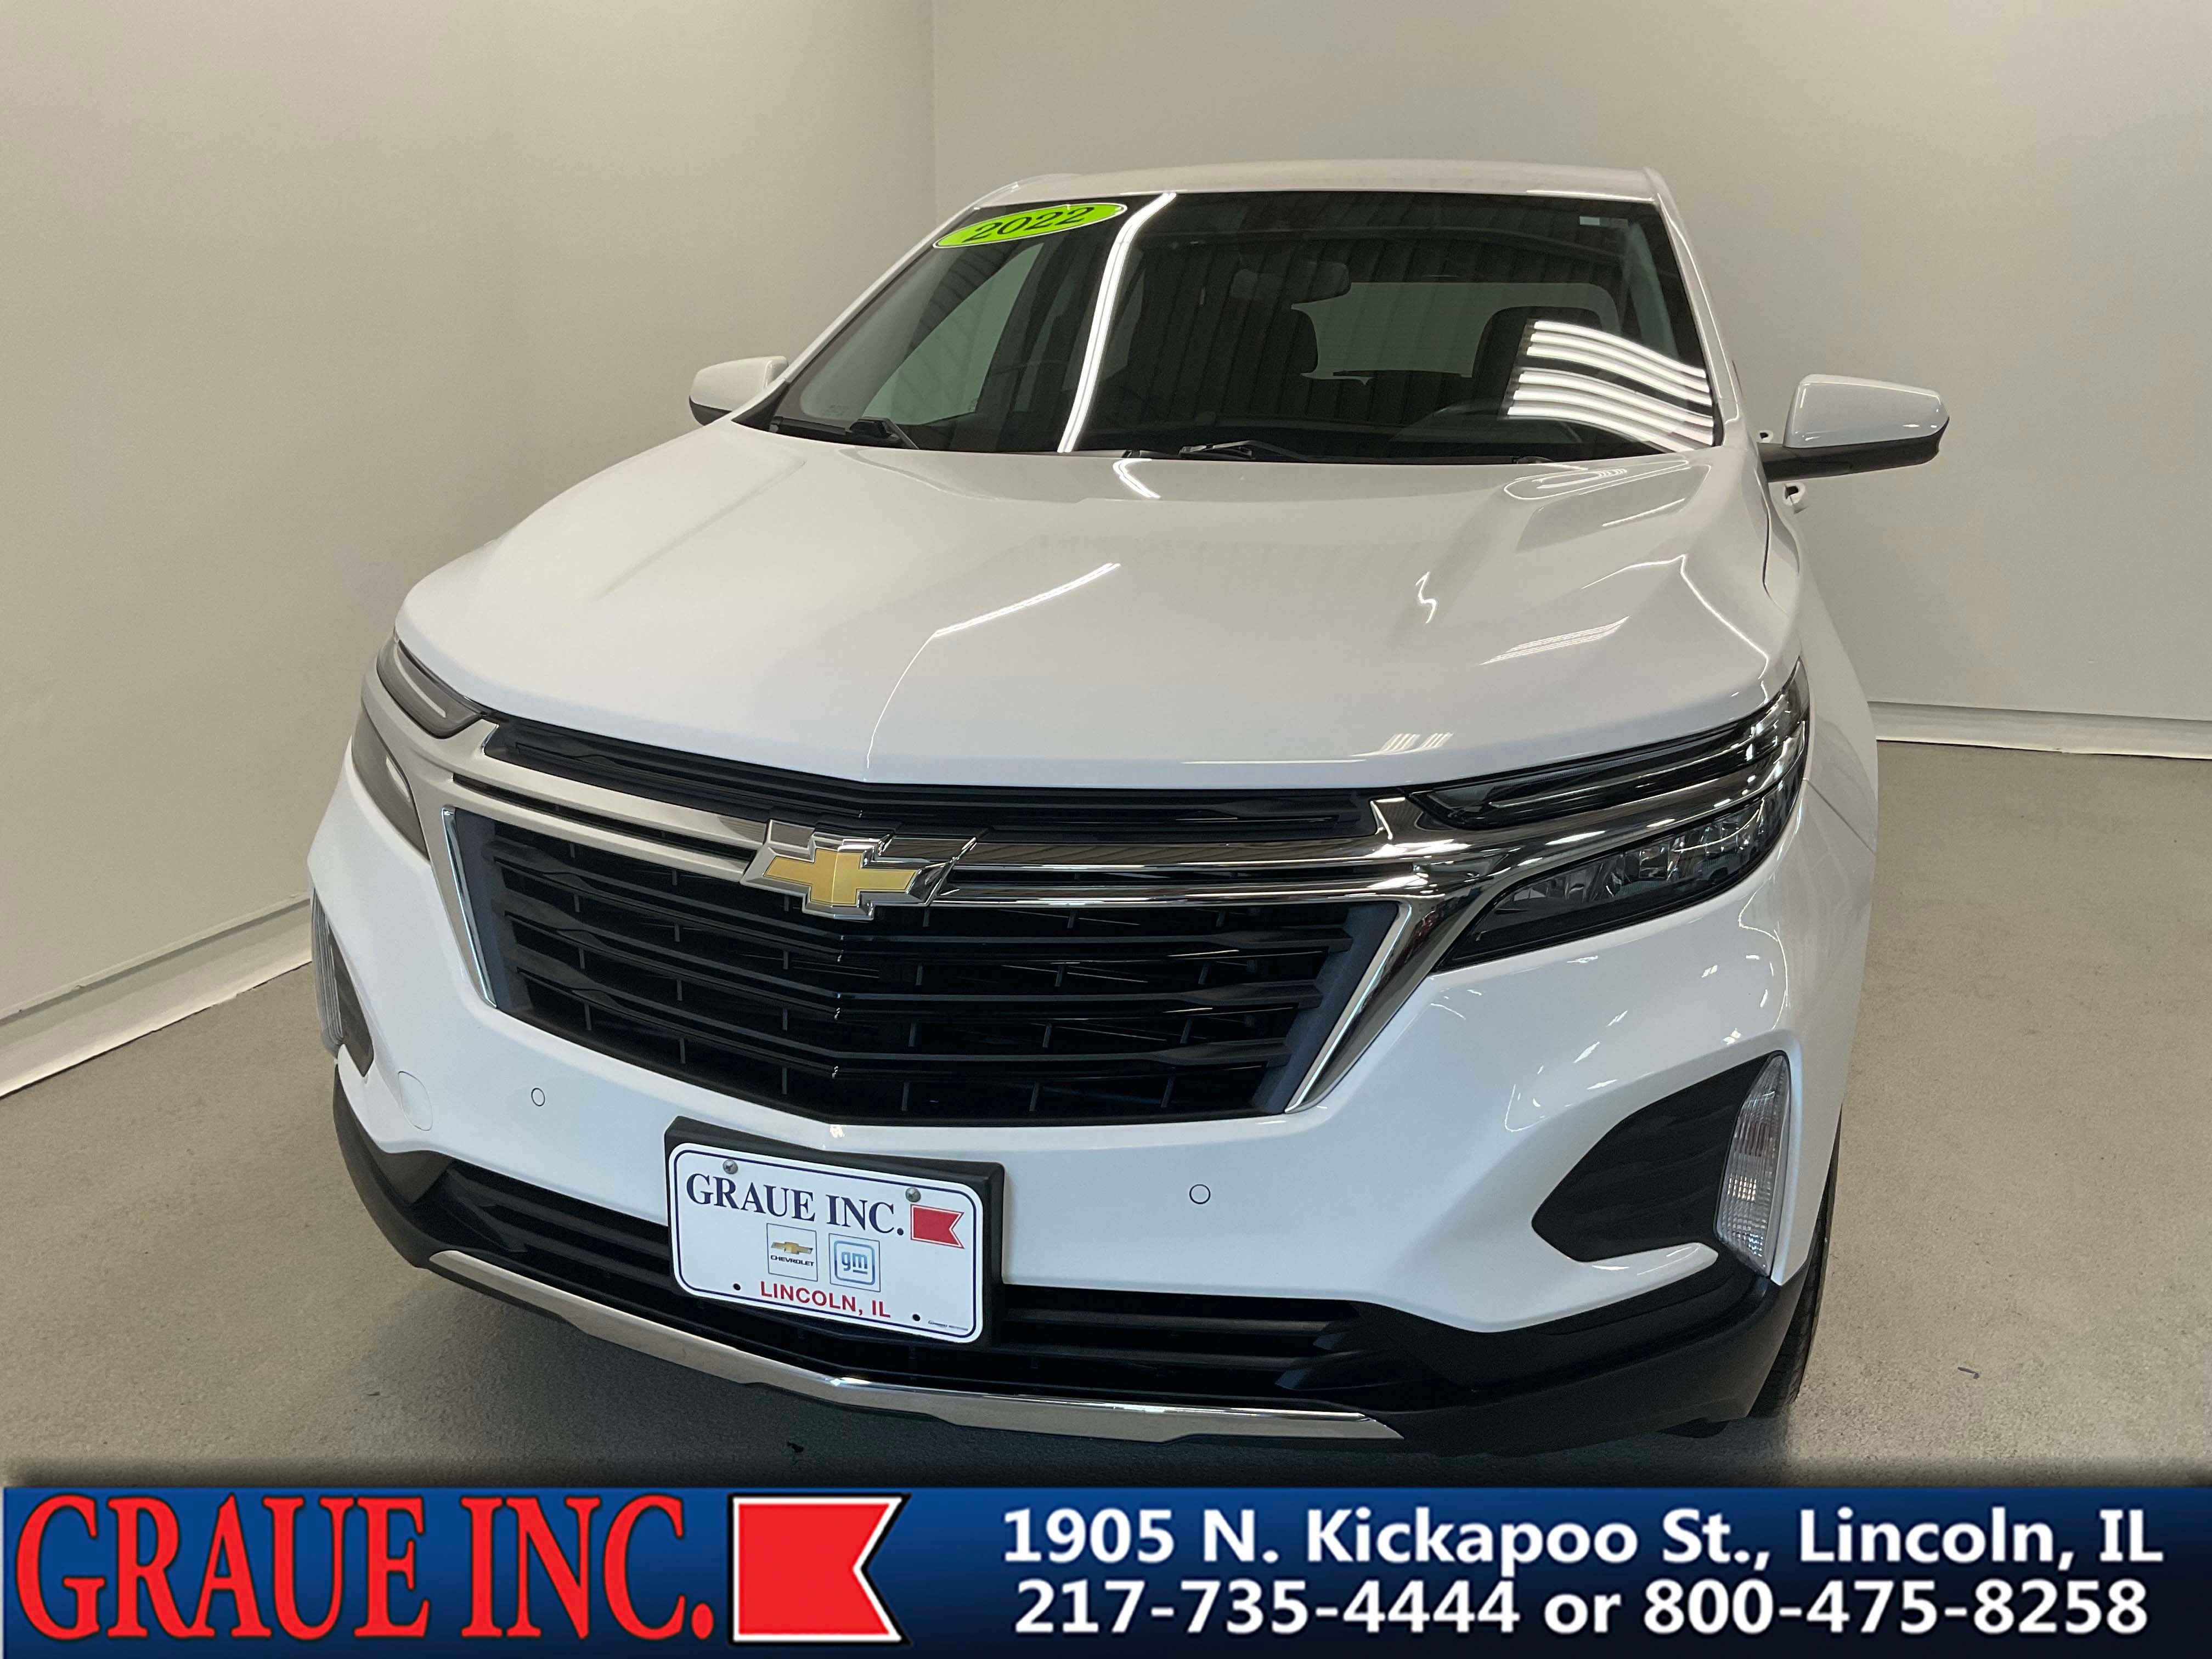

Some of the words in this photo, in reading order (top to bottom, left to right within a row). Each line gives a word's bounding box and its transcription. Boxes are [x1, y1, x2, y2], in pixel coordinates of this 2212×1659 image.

[961, 206, 1094, 243] 2022
[686, 1172, 816, 1222] GRAUE
[825, 1194, 904, 1236] INC.
[770, 1255, 815, 1267] CHEVROLET
[841, 1251, 868, 1271] gm
[760, 1281, 863, 1316] LINCOLN,
[872, 1300, 891, 1318] IL
